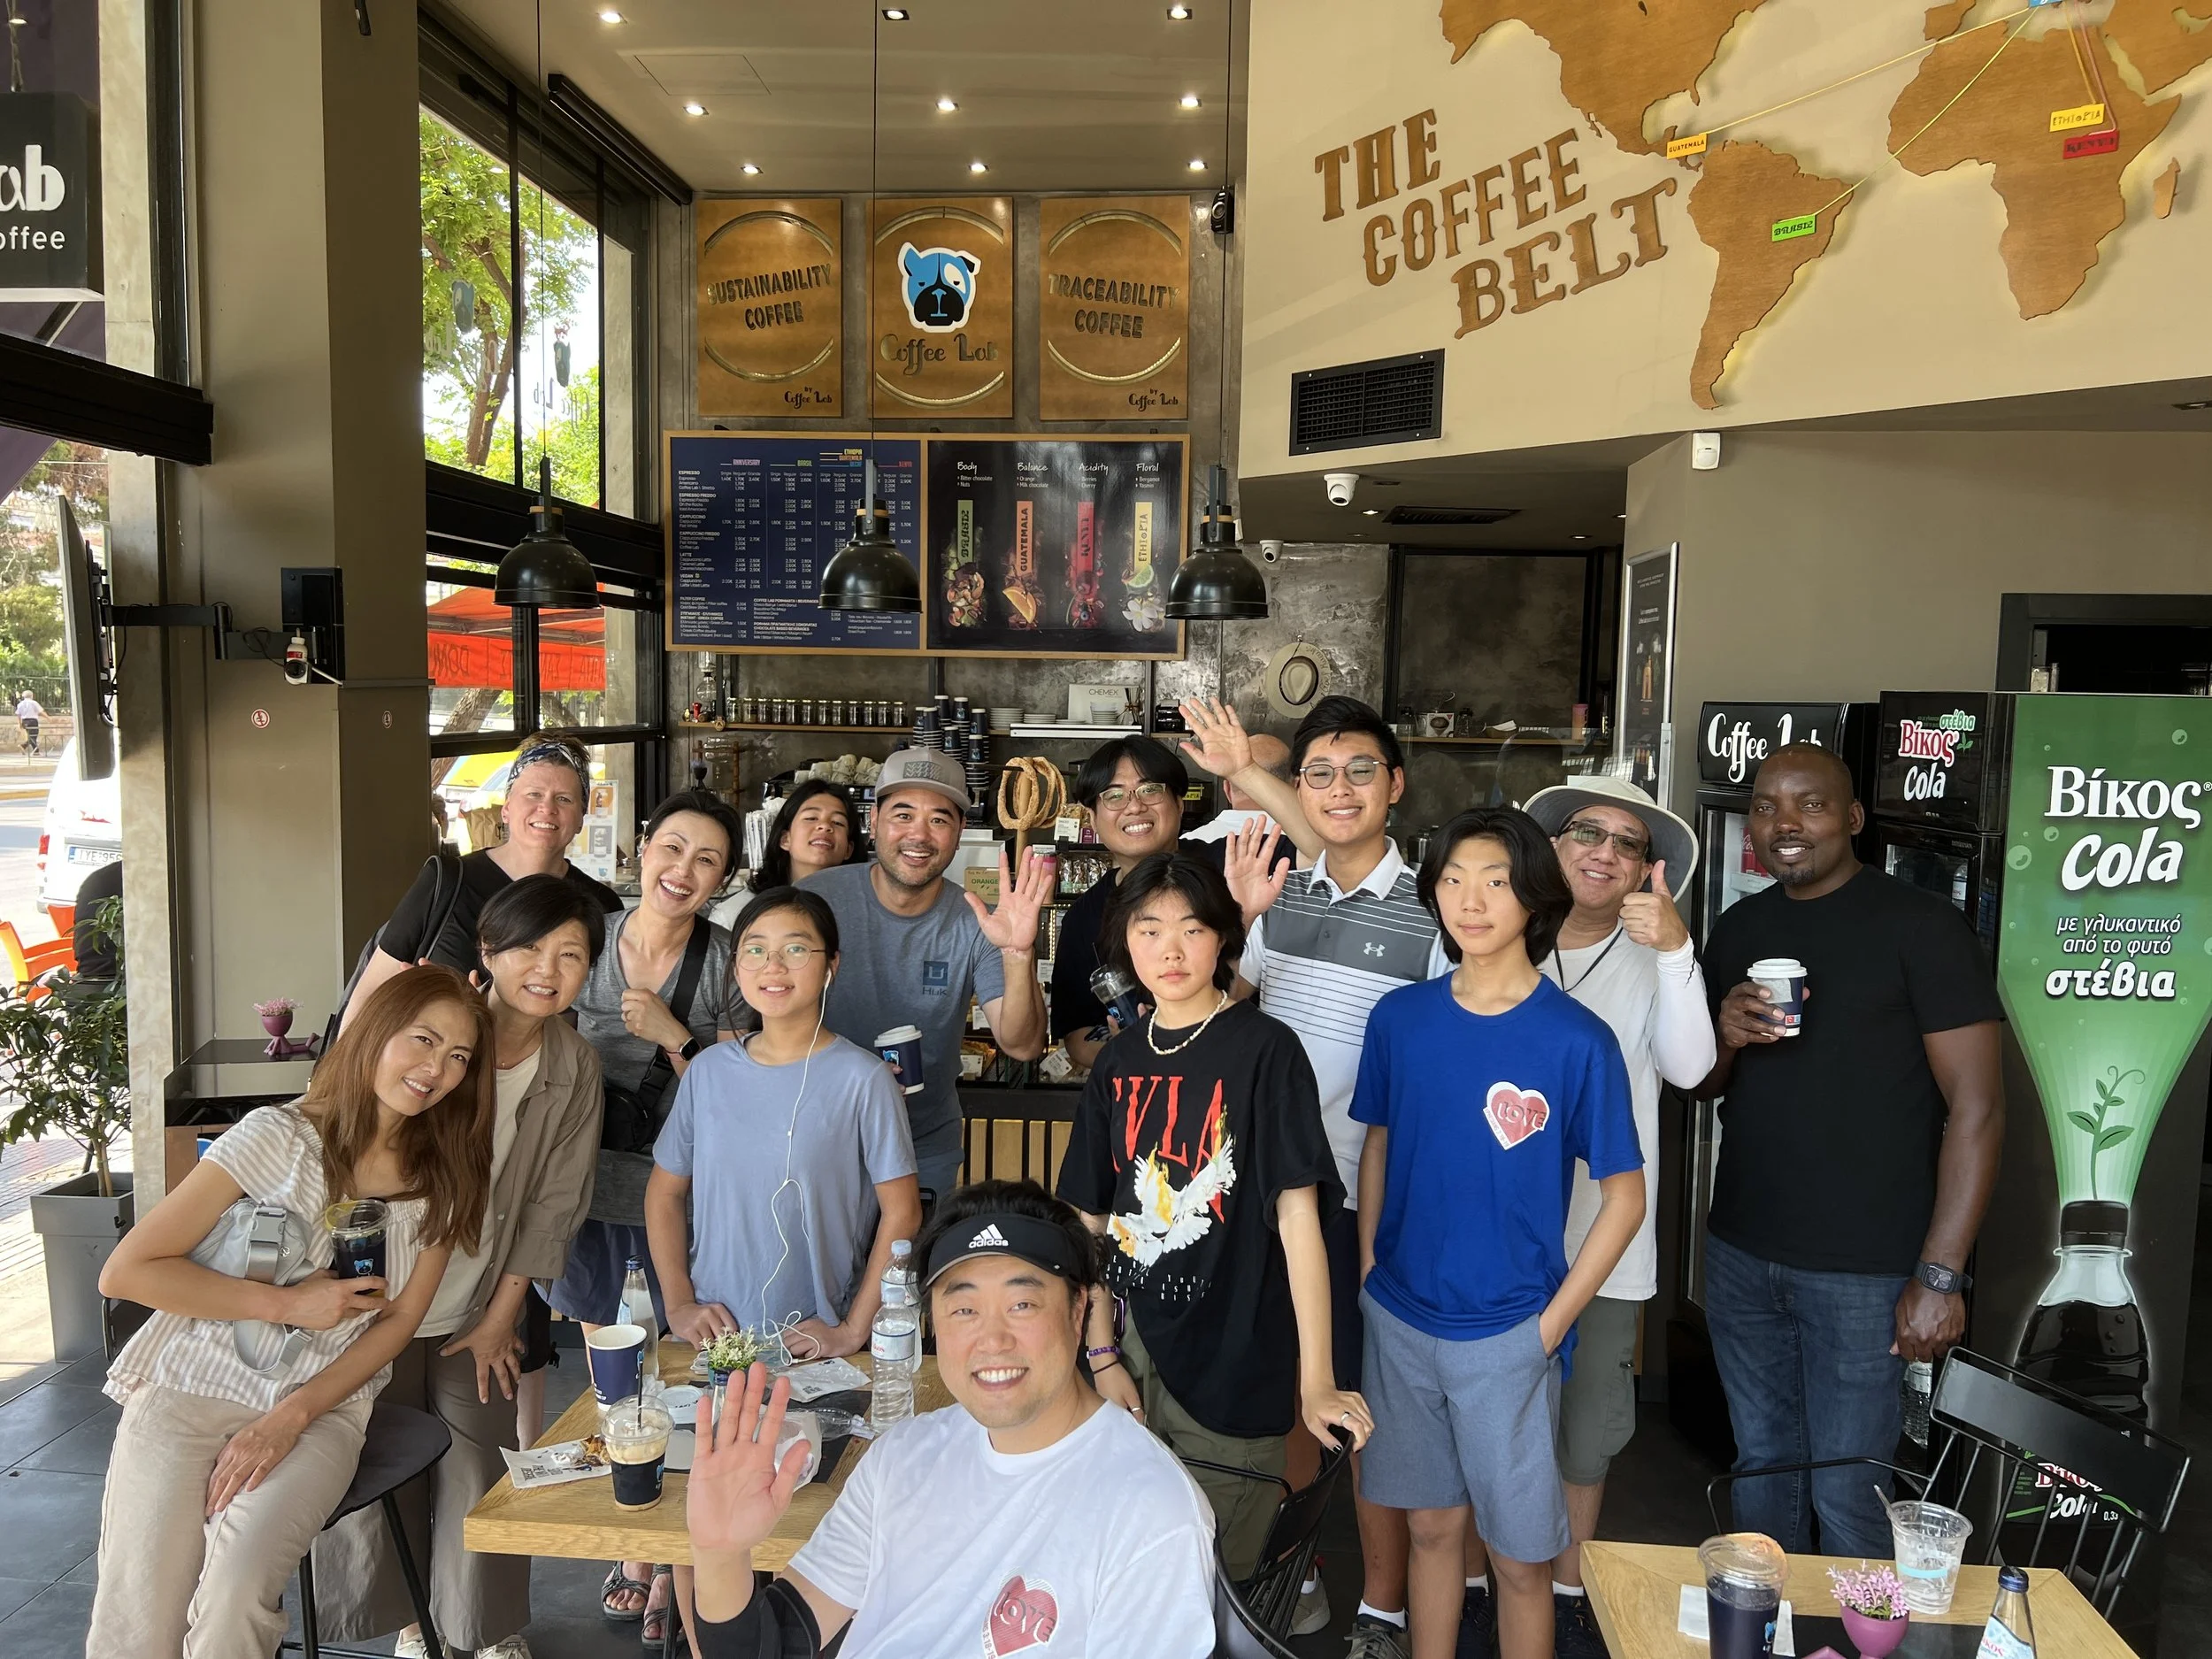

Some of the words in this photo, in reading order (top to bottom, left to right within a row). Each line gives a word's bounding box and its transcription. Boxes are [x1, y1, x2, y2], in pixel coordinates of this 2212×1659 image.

[2053, 110, 2101, 126] ETHIOPIA
[1669, 139, 1705, 153] GUATEMALA
[0, 144, 65, 211] ab
[1315, 109, 1440, 221] THE
[1363, 128, 1586, 286] COFFEE
[1451, 178, 1678, 339] BELT
[707, 264, 833, 305] SUSTAINABILITY
[1048, 273, 1180, 309] TRACEABILITY
[745, 300, 804, 330] COFFEE
[1074, 309, 1144, 339] COFFEE
[880, 333, 947, 376] Coffee
[954, 333, 999, 361] Lab
[784, 390, 811, 408] Coffee
[813, 390, 833, 403] Lab
[1128, 393, 1157, 412] Coffee
[1159, 393, 1179, 406] Lab
[957, 461, 978, 475] Body
[1017, 462, 1048, 472] Balance
[1079, 463, 1109, 476] Acidity
[1135, 462, 1160, 472] Floral
[1019, 508, 1029, 572] GUATEMALA
[1138, 513, 1148, 563] ETHIOPIA
[1939, 709, 1976, 732] στέβια
[1707, 712, 1769, 783] Coffee
[1777, 712, 1823, 747] Lb
[1899, 720, 1955, 768] Βίκος
[1903, 762, 1947, 801] Cola
[2044, 766, 2202, 829] Βίκος
[2061, 826, 2185, 891] Cola
[2055, 917, 2079, 935] με
[2084, 913, 2182, 936] γλυκαντικό
[2062, 934, 2098, 954] από
[2102, 939, 2123, 954] το
[2126, 935, 2172, 958] φυτό
[2046, 958, 2177, 999] στέβια
[1497, 1101, 1547, 1130] LOVE
[969, 1239, 1009, 1248] adidas
[994, 1592, 1056, 1644] LOVE
